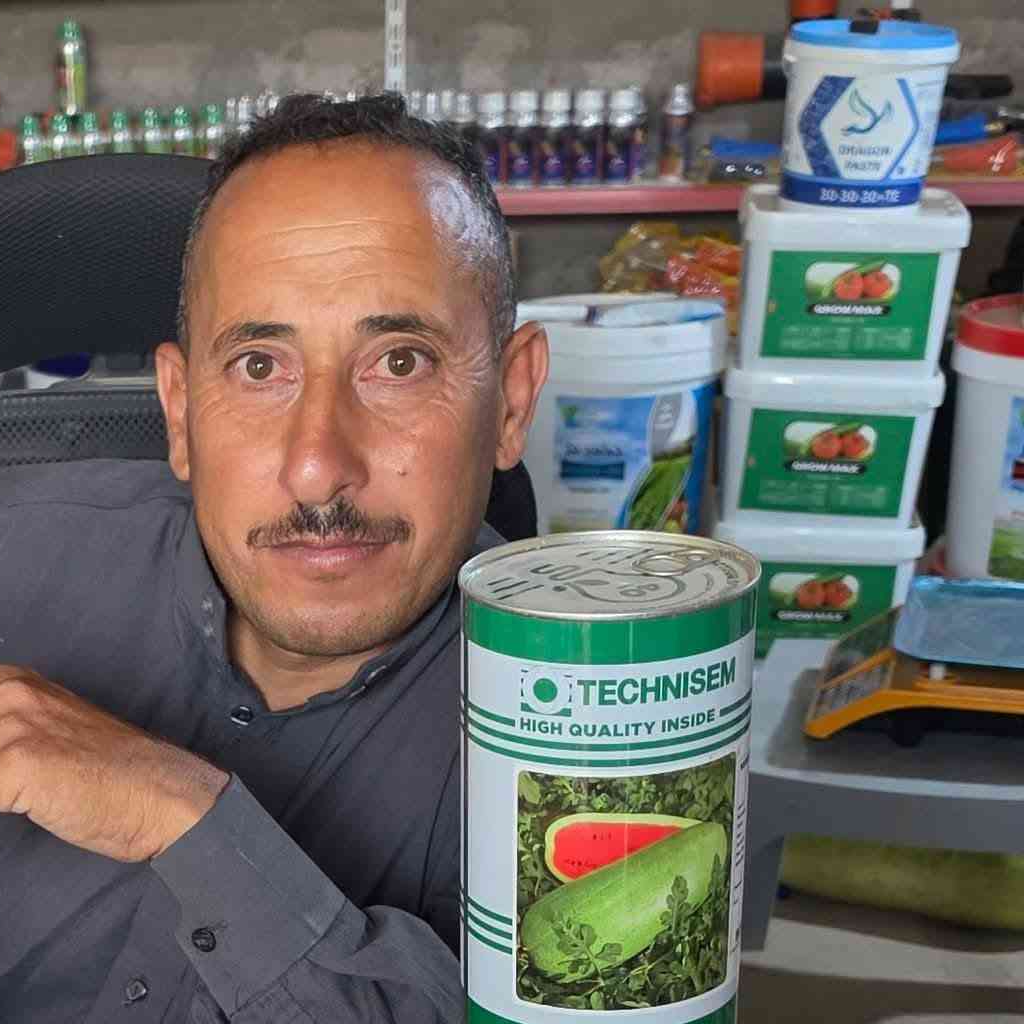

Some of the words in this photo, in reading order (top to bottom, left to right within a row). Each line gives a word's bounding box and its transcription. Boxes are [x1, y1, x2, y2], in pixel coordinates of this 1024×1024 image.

[577, 656, 737, 706] TECHNISEM
[520, 717, 562, 736] HIGH
[569, 720, 655, 737] QUALITY
[661, 708, 716, 733] INSIDE
